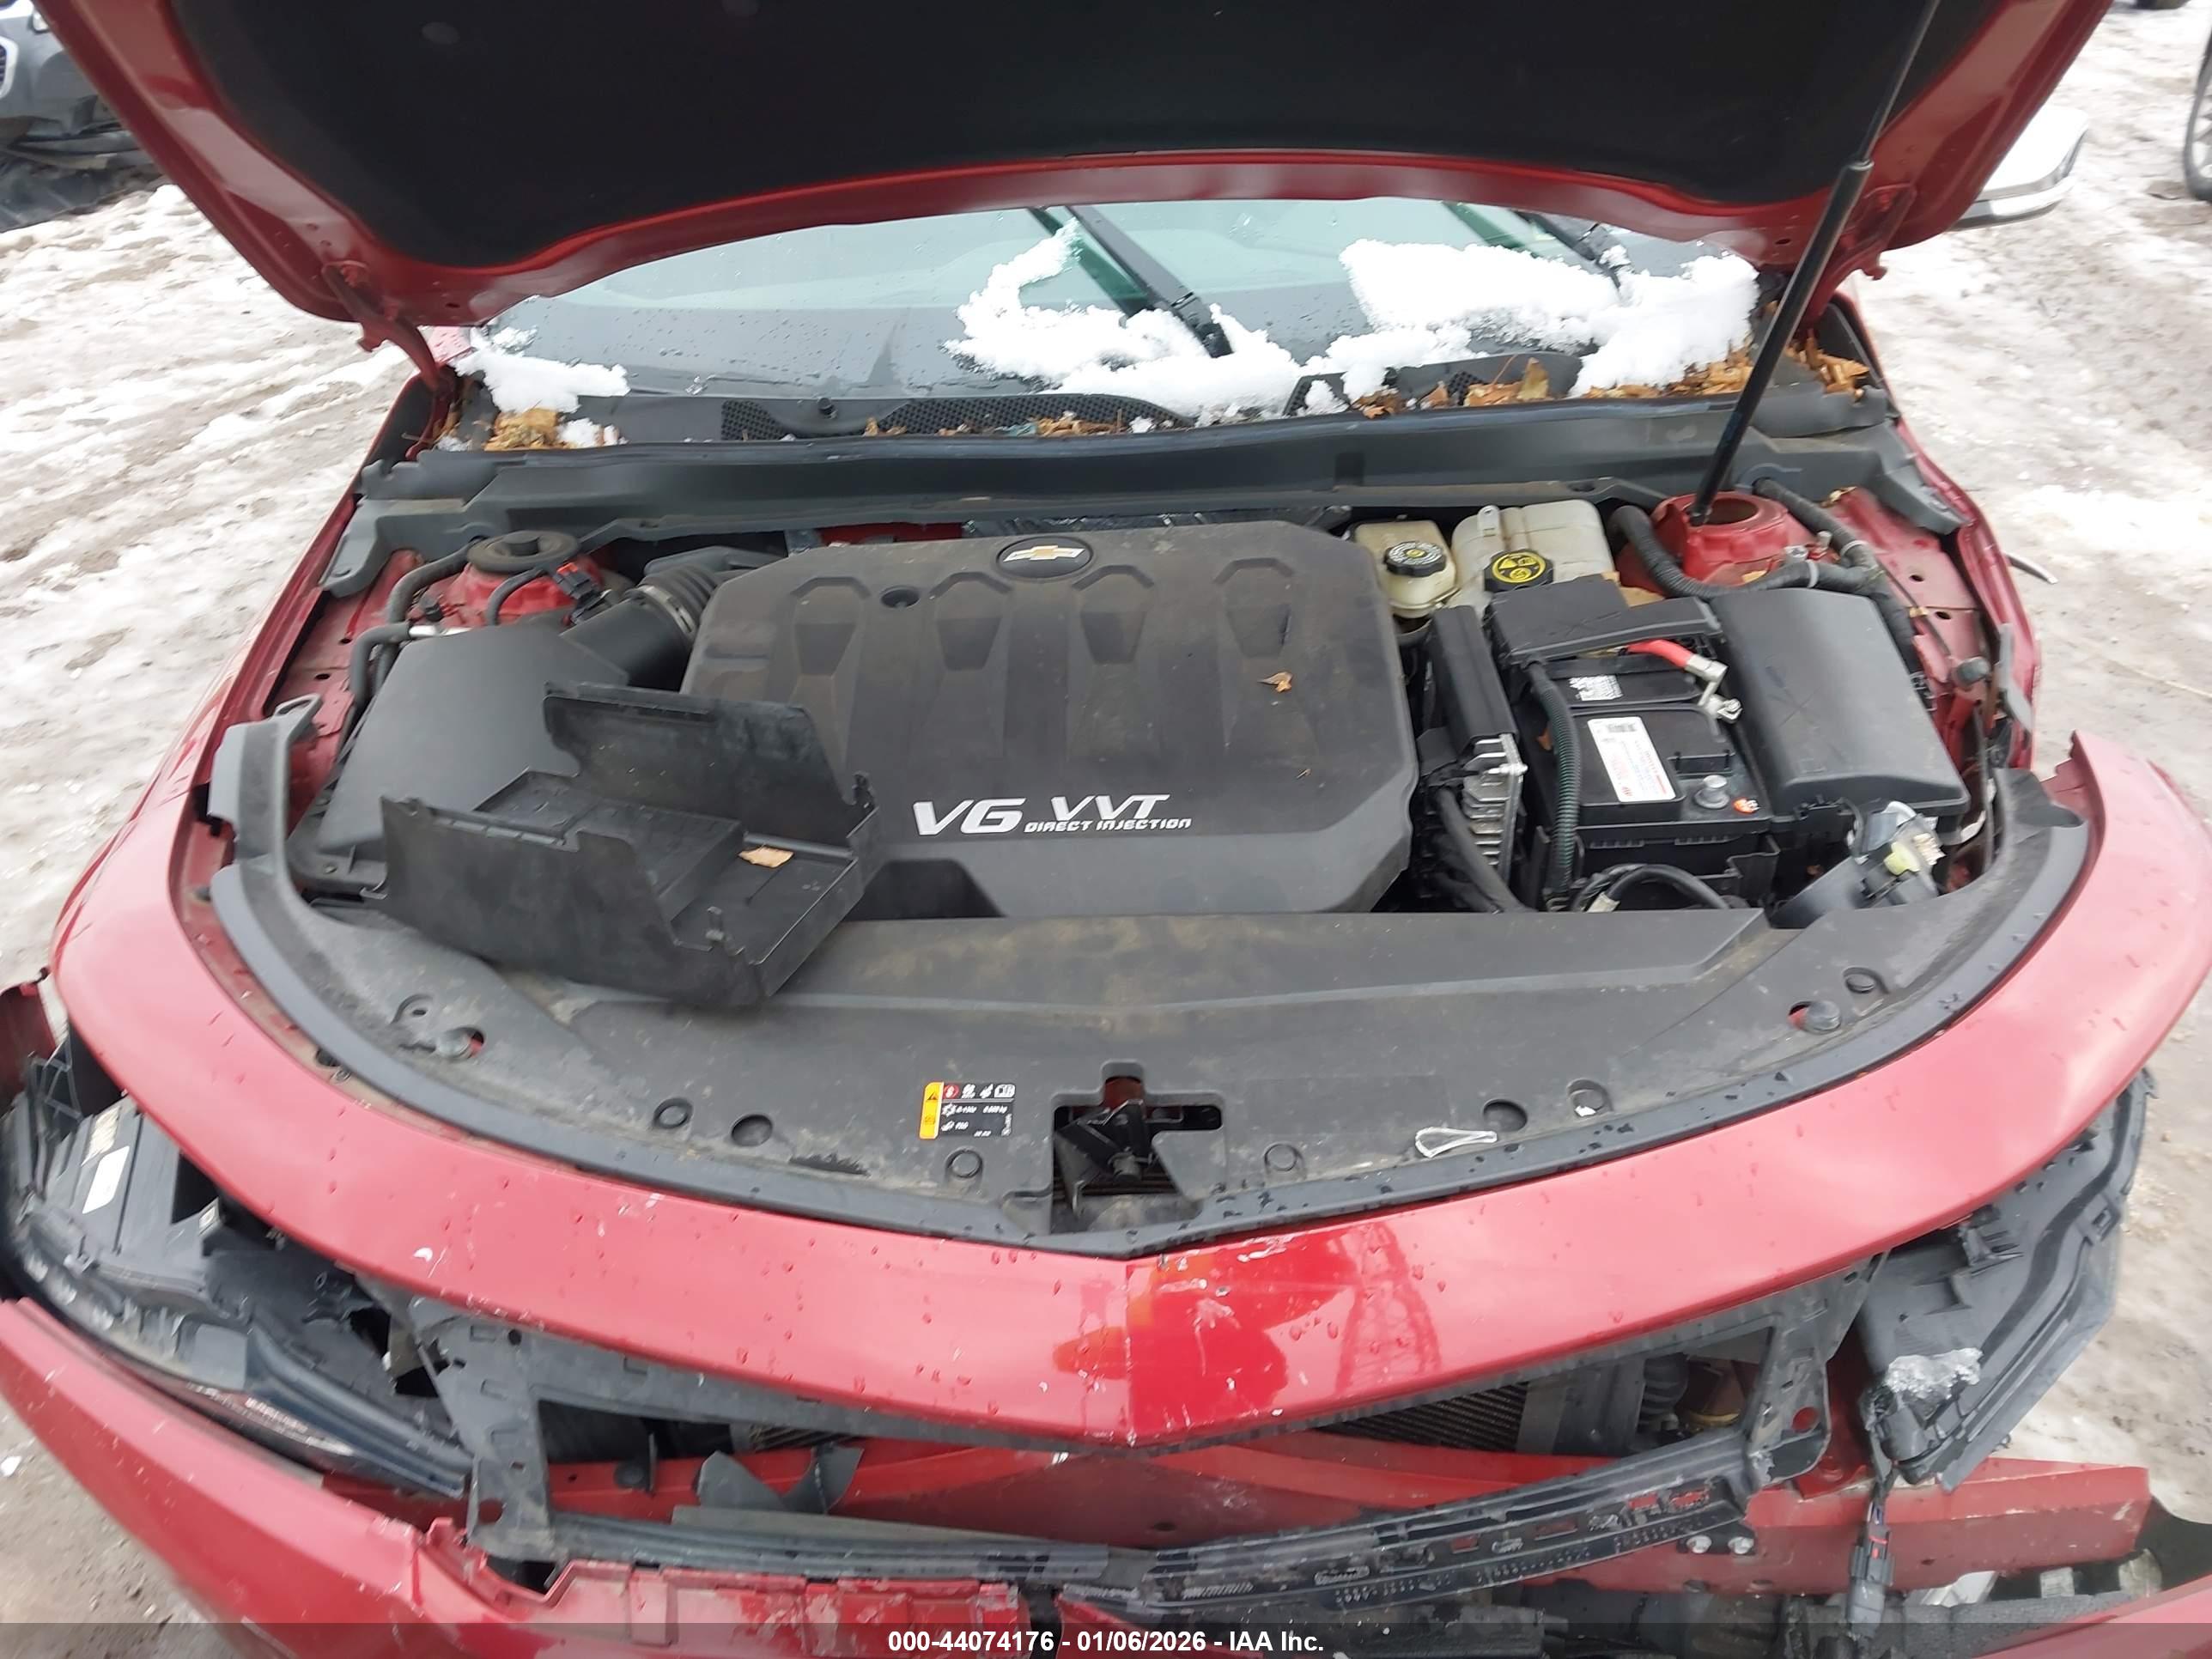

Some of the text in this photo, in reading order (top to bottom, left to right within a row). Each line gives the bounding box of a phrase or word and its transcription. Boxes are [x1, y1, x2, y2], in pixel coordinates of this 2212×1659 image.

[913, 794, 1171, 836] V6 VVT
[1024, 818, 1192, 833] DIRECT INJECTION
